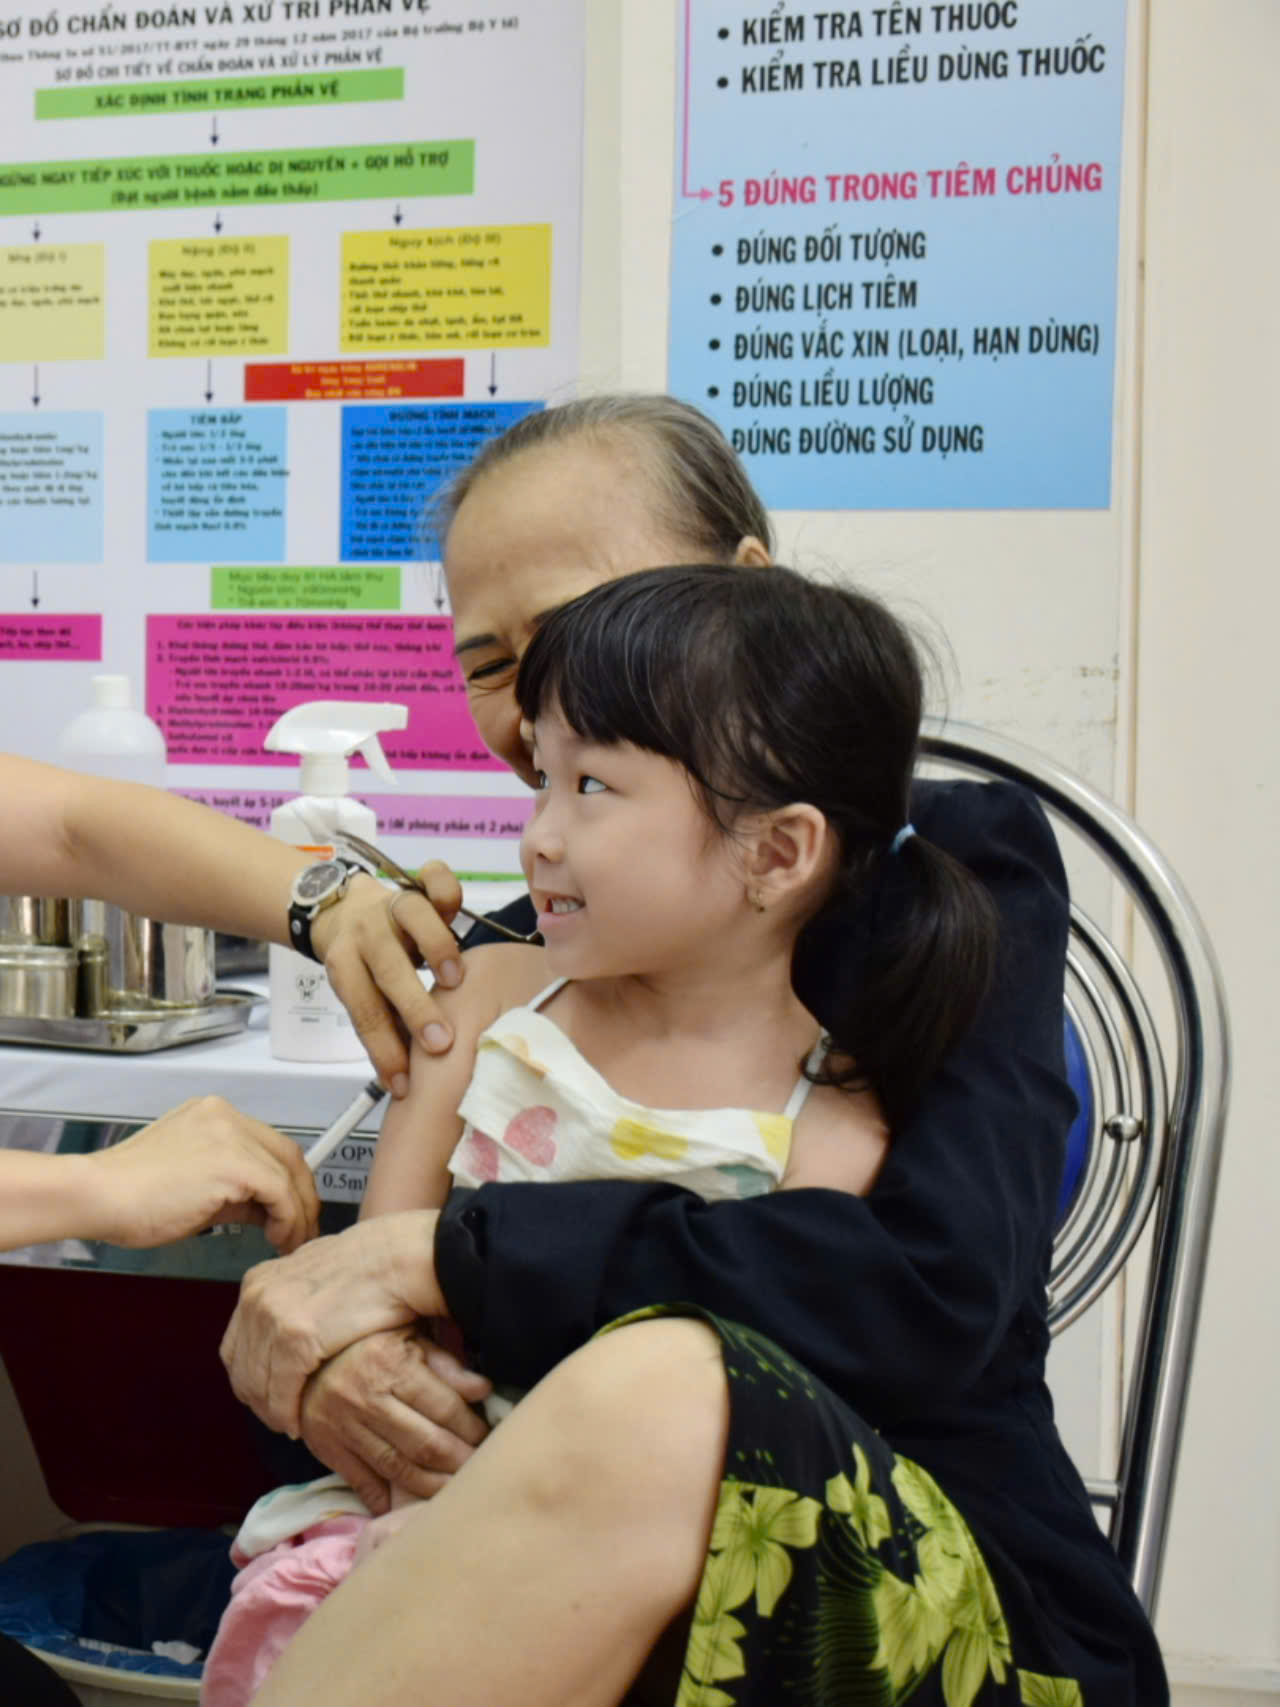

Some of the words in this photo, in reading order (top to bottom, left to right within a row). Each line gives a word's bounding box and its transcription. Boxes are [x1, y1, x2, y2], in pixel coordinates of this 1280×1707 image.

[29, 11, 60, 37] ĐỒ
[135, 3, 197, 29] ĐOÁN
[742, 1, 806, 46] KIỂM
[814, 11, 864, 40] TRA
[872, 1, 922, 36] TÊN
[741, 49, 805, 94] KIỂM
[814, 60, 862, 88] TRA
[871, 43, 928, 86] LIỀU
[937, 45, 1009, 82] DÙNG
[1017, 33, 1106, 77] THUỐC
[719, 179, 735, 208] 5
[744, 169, 817, 206] ĐÚNG
[825, 171, 918, 202] TRONG
[926, 161, 997, 197] TIÊM
[1006, 153, 1103, 195] CHỦNG
[736, 231, 797, 266] ĐÚNG
[804, 223, 842, 263] ĐỐI
[850, 228, 927, 267] TƯỢNG
[735, 278, 796, 313] ĐÚNG
[802, 283, 854, 317] LỊCH
[861, 274, 918, 309] TIÊM
[734, 325, 794, 361] ĐÚNG
[801, 318, 845, 359] VẮC
[851, 329, 890, 357] XIN
[898, 327, 965, 363] (LOẠI,
[972, 326, 1020, 362] HẠN
[1028, 318, 1100, 357] DÙNG)
[733, 373, 793, 409] ĐÚNG
[799, 366, 850, 407] LIỀU
[858, 373, 935, 414] LƯỢNG
[731, 421, 791, 455] ĐÚNG
[798, 419, 876, 454] ĐƯỜNG
[883, 414, 916, 453] SỬ
[922, 424, 984, 459] DỤNG
